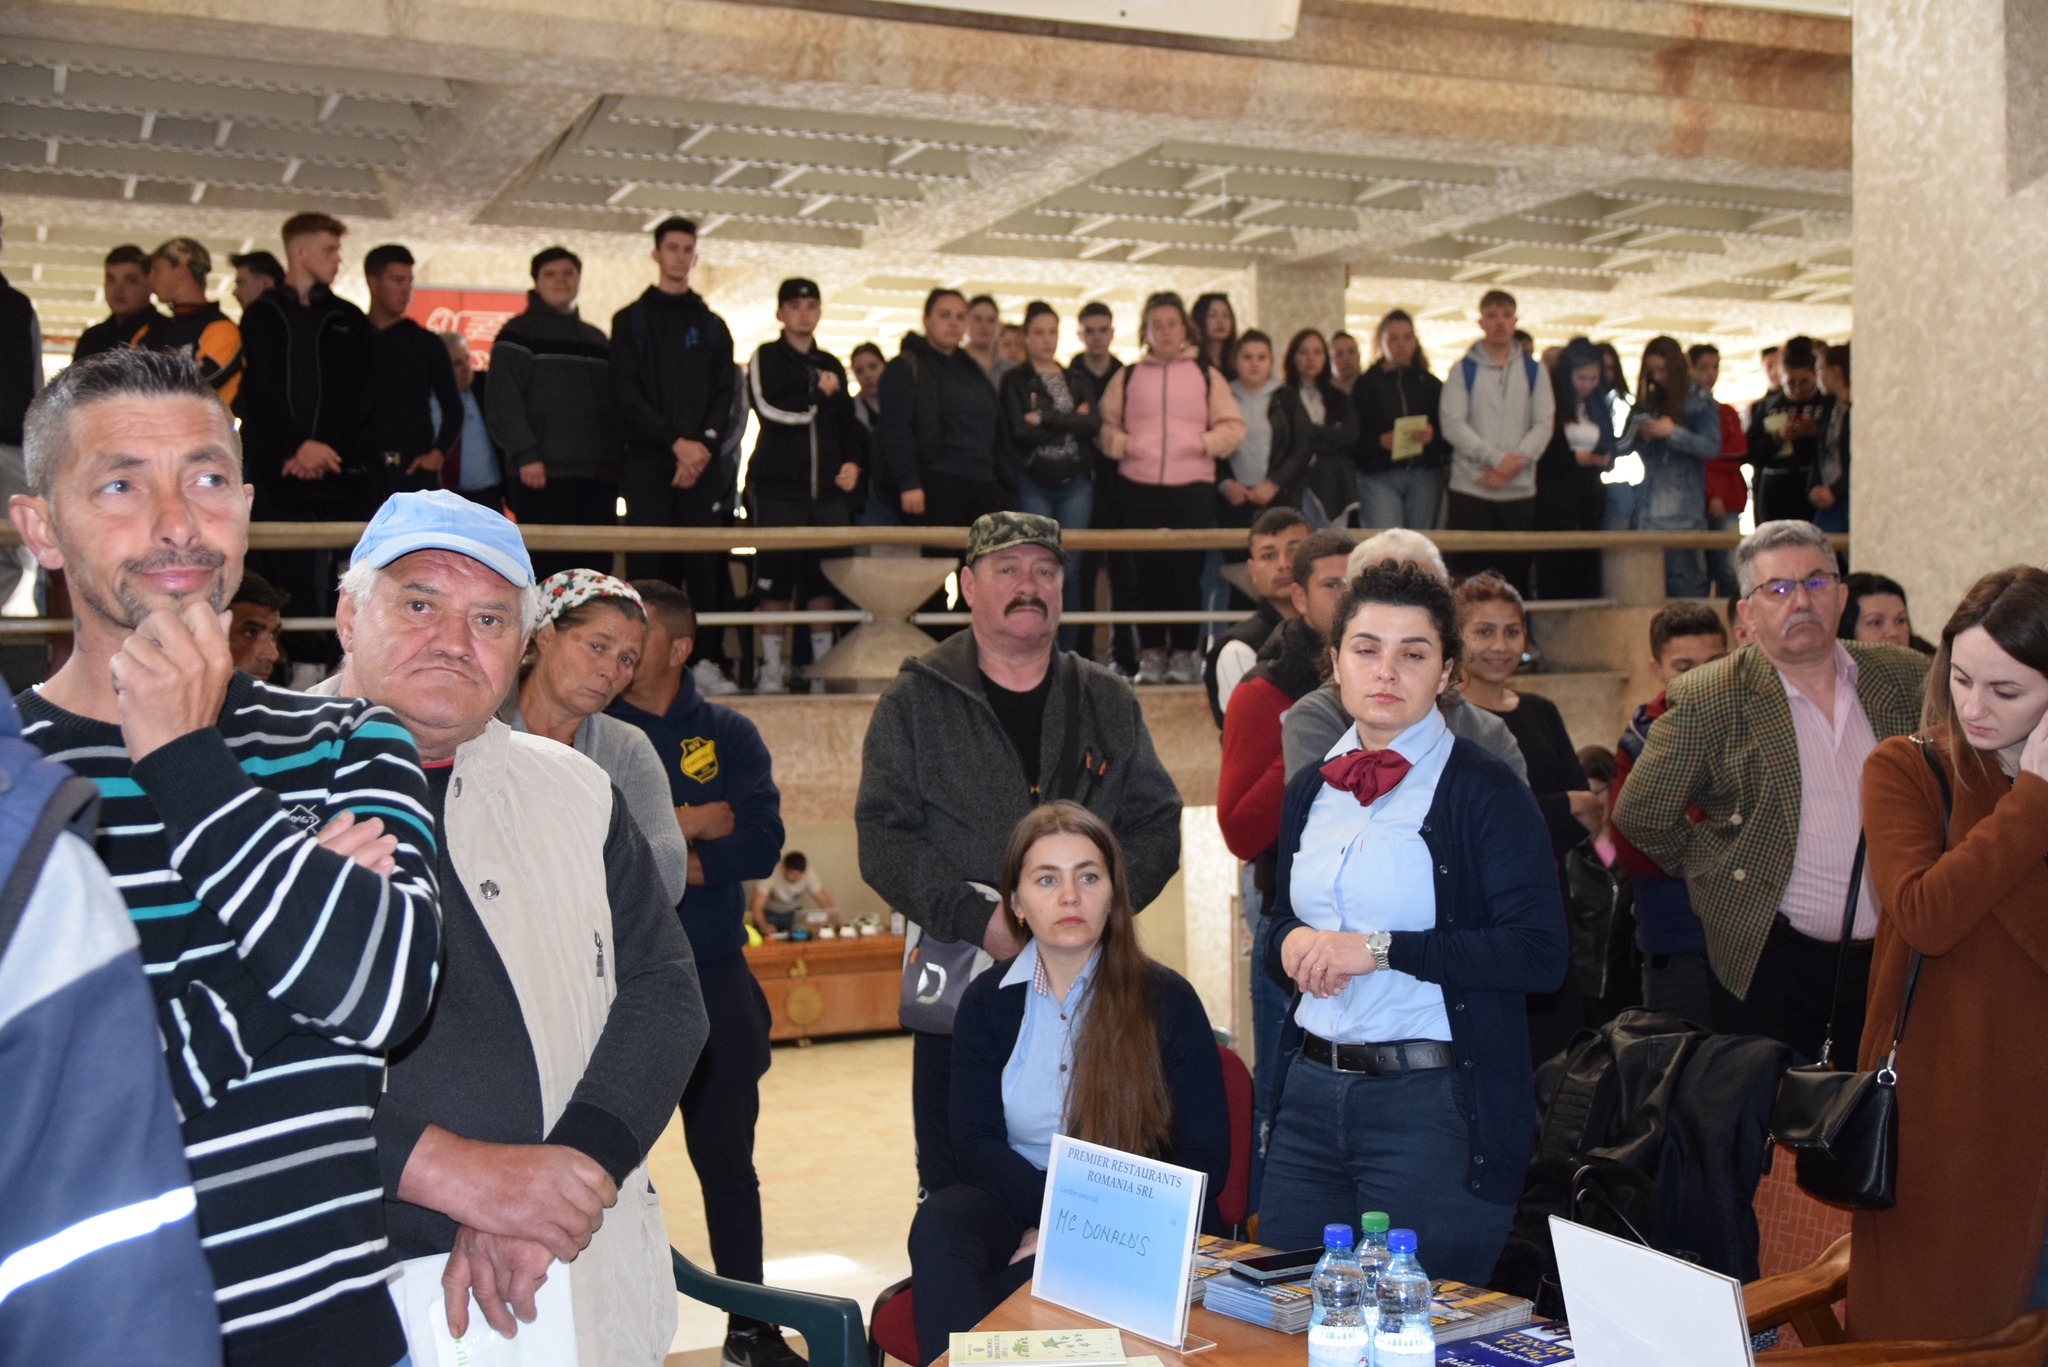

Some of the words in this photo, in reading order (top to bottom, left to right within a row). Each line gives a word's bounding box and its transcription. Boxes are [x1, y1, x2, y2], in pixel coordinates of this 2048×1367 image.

[1067, 1147, 1110, 1169] PREMIER
[1110, 1159, 1182, 1188] RESTAURANTS
[1087, 1170, 1133, 1193] ROMANIA
[1136, 1184, 1154, 1199] SRL
[1082, 1219, 1150, 1257] DONALD'S
